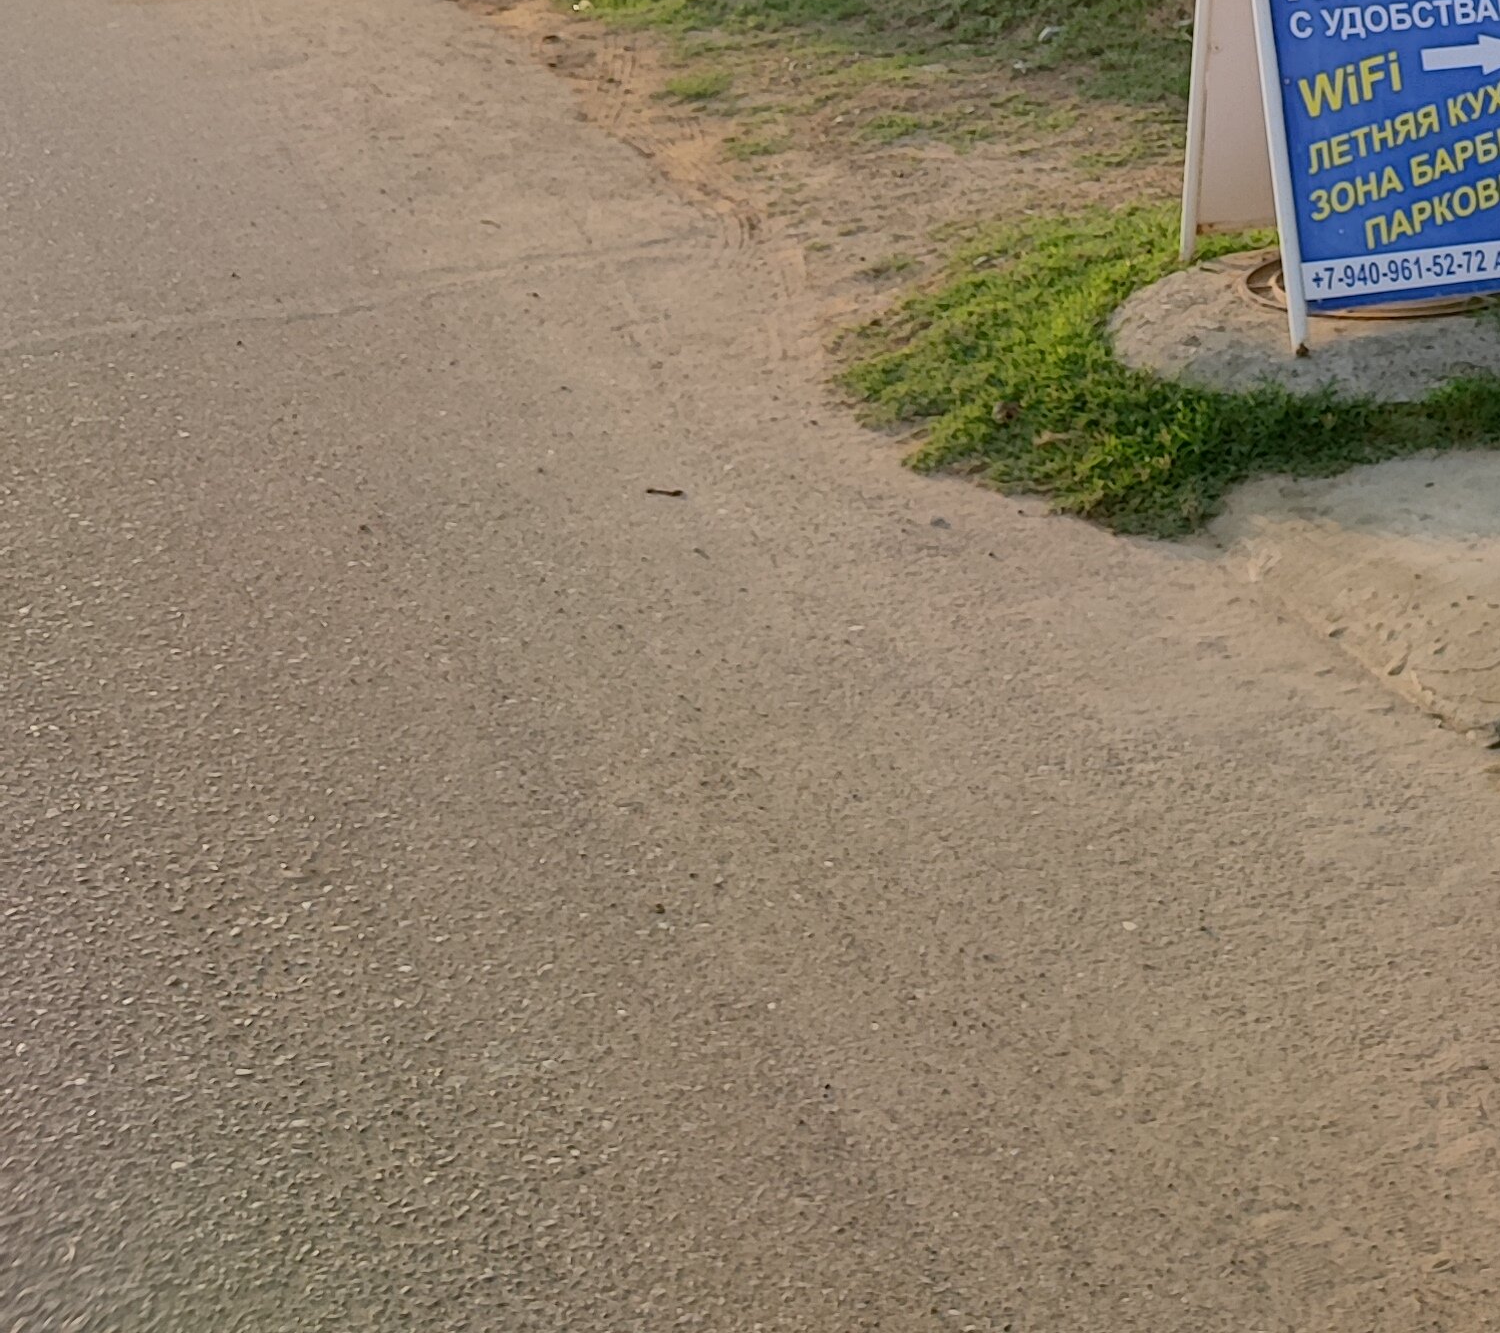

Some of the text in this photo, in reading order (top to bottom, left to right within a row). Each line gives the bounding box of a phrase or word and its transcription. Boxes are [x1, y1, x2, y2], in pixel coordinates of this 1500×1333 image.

[1289, 10, 1313, 40] С
[1298, 51, 1403, 119] WiFi
[1308, 103, 1441, 176] ЛЕТНЯЯ
[1309, 169, 1404, 222] ЗОНА
[1311, 250, 1487, 291] +7-940-961-52-72
